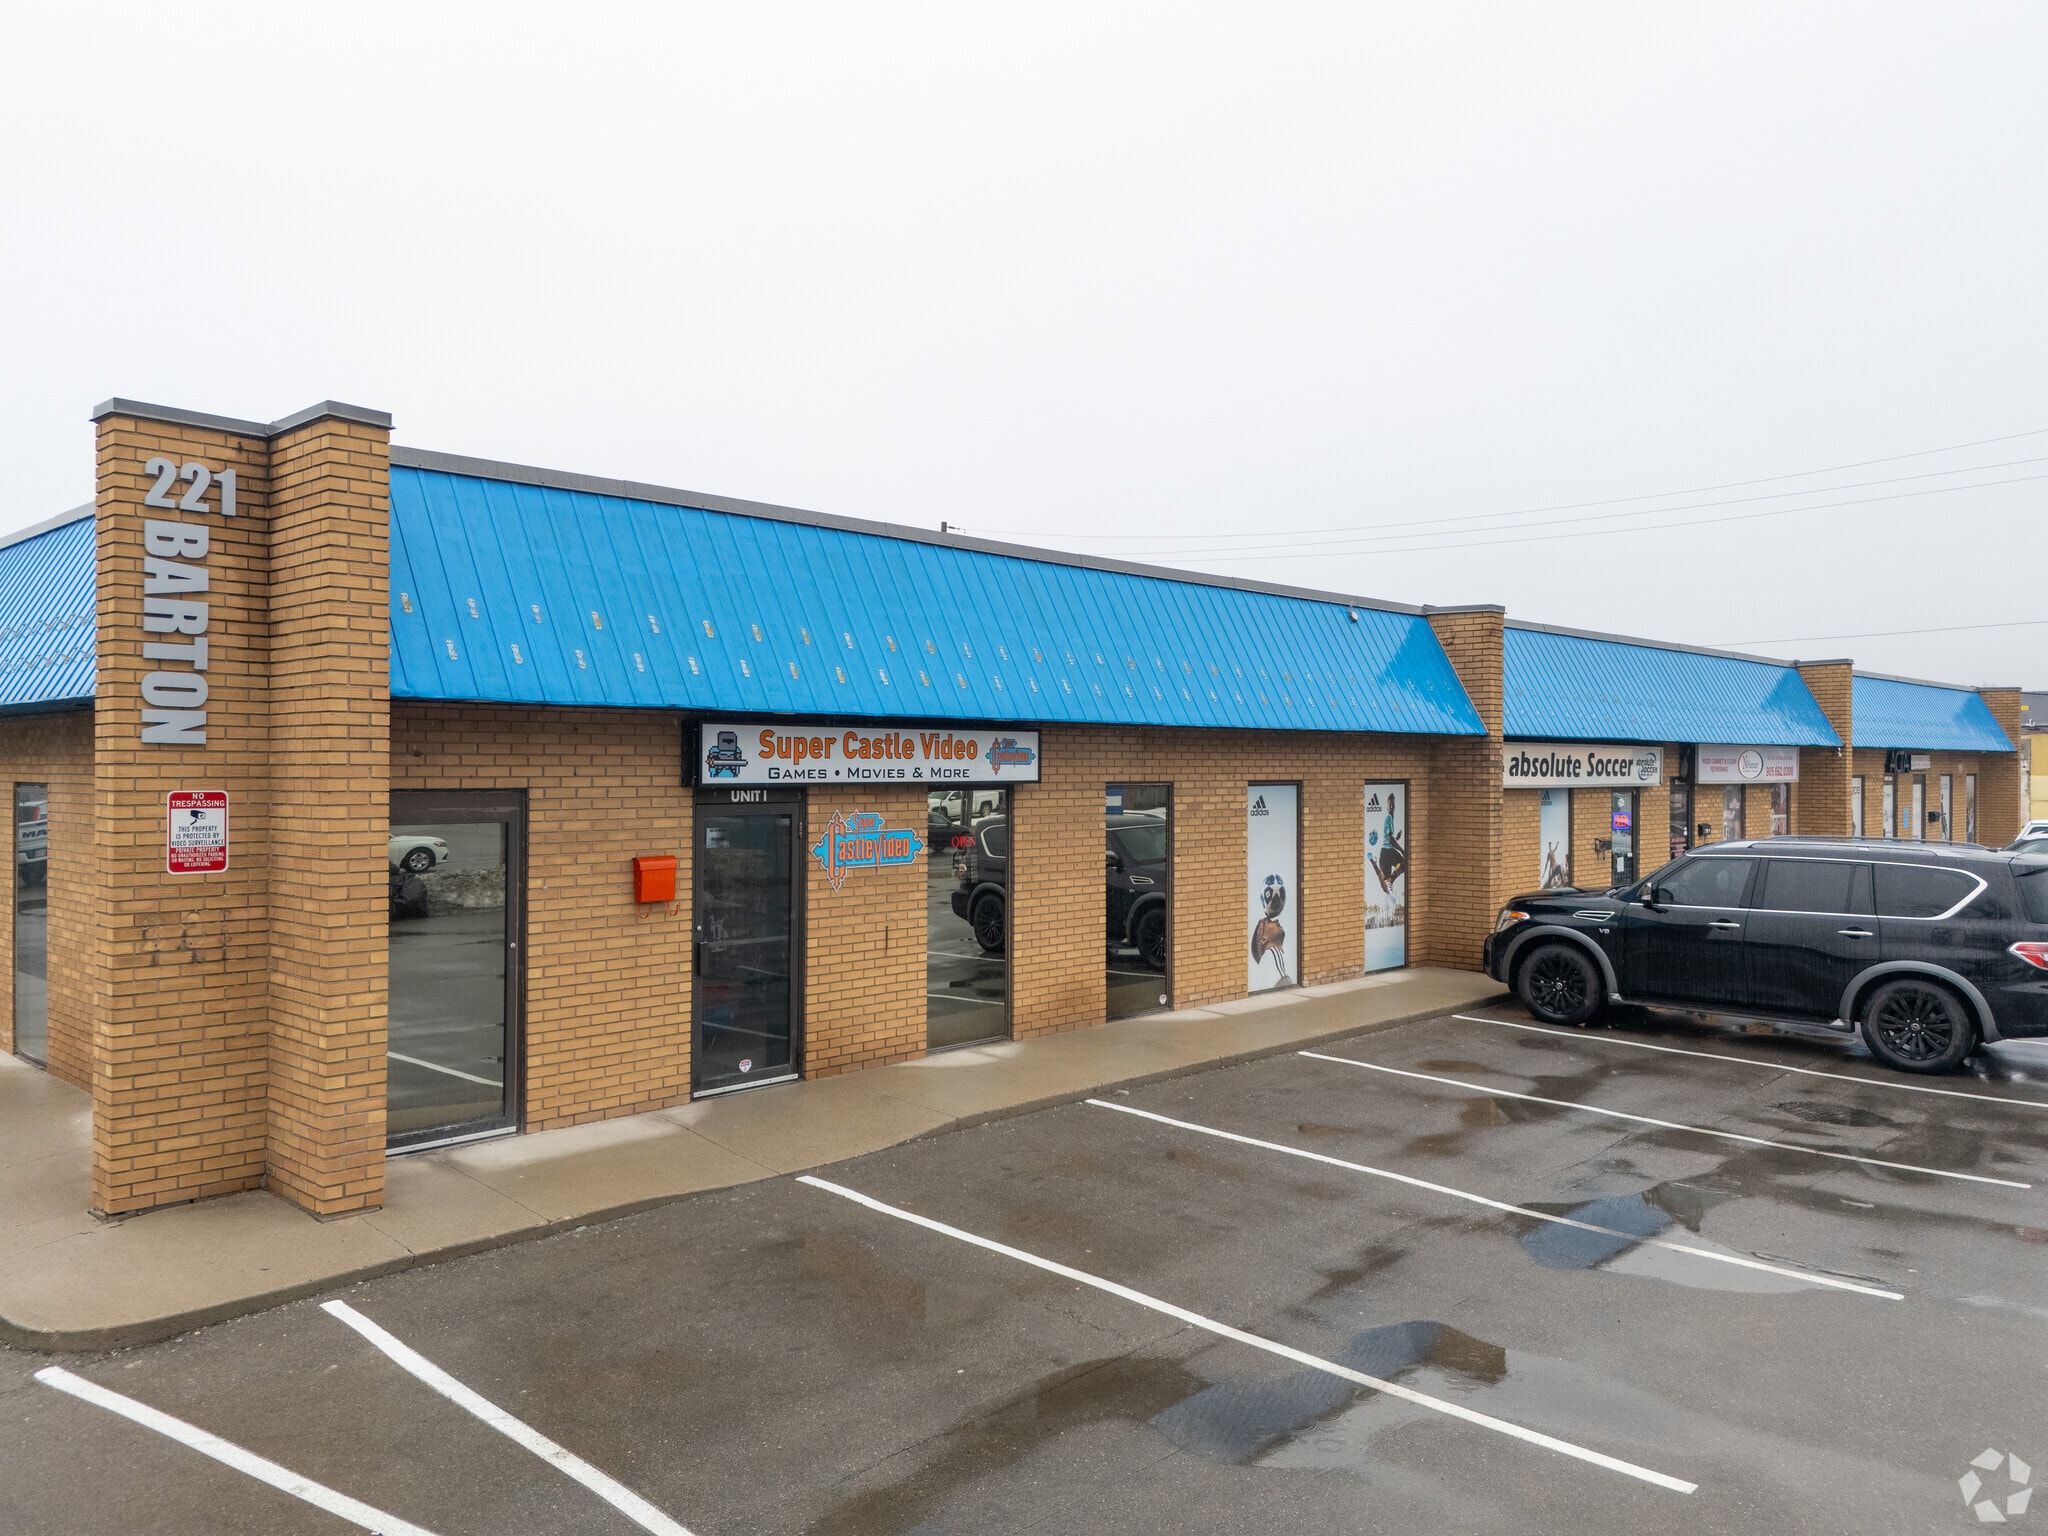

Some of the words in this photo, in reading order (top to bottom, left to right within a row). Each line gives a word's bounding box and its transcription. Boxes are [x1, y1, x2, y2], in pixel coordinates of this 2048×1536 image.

[144, 457, 237, 517] 221
[140, 519, 209, 745] BARTON
[758, 729, 837, 766] Super
[842, 731, 915, 760] Castle
[921, 732, 978, 760] Video
[768, 767, 828, 780] GAMES
[847, 767, 905, 779] MOVIES
[912, 767, 923, 779] &
[930, 767, 971, 779] MORE
[1509, 751, 1582, 778] absolute
[1586, 752, 1634, 777] Soccer
[731, 790, 761, 802] UNIT
[1250, 808, 1270, 816] adidas
